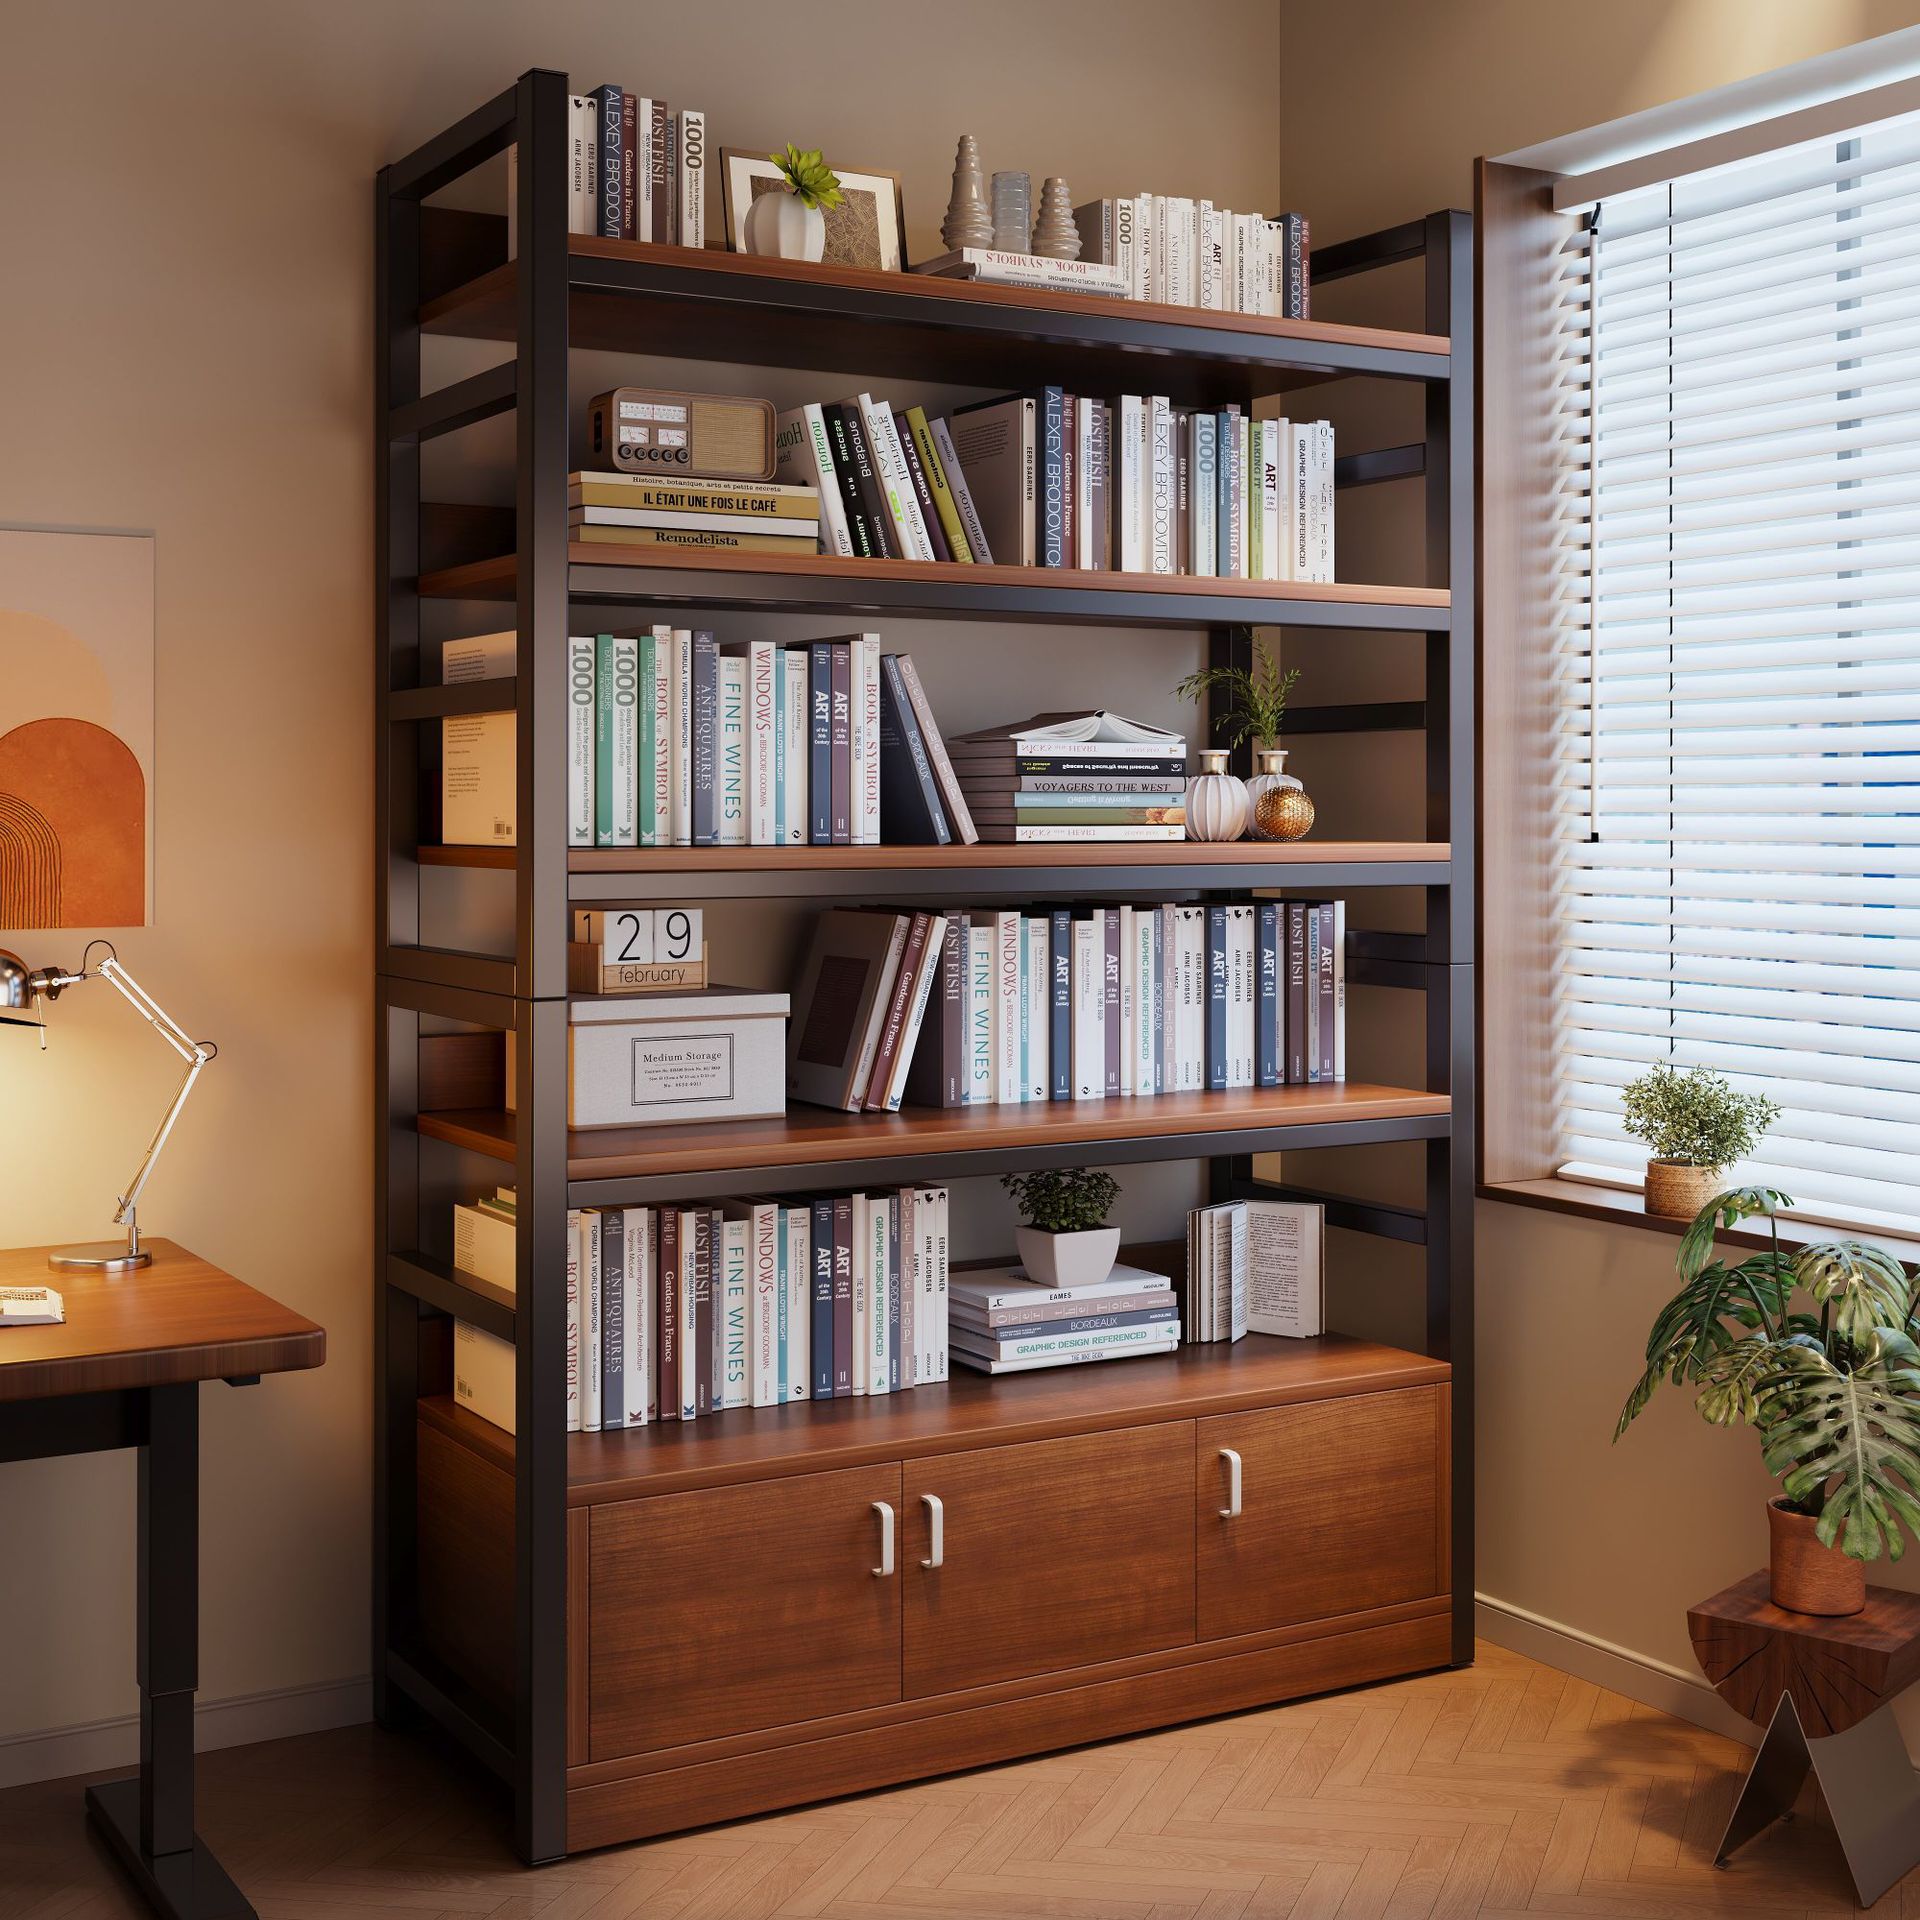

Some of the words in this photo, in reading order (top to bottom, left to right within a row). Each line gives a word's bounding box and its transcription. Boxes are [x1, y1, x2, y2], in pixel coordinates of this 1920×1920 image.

[653, 105, 664, 147] LOST
[686, 117, 702, 169] 1000
[574, 139, 582, 156] ARNE
[574, 158, 582, 192] JACOBSEN
[625, 149, 634, 186] Gardens
[653, 150, 664, 184] FISH
[625, 188, 634, 197] in
[625, 199, 634, 230] France
[1119, 204, 1132, 244] 1000
[1213, 243, 1222, 265] ART
[1292, 216, 1302, 264] ALEXEY
[1047, 390, 1061, 458] ALEXEY
[1091, 404, 1102, 448] LOST
[1199, 420, 1215, 473] 1000
[632, 476, 663, 485] Histoire,
[666, 479, 705, 488] botanique,
[1064, 452, 1073, 491] Gardens
[1091, 451, 1102, 487] FISH
[1179, 458, 1187, 475] EERO
[1265, 462, 1276, 491] ART
[643, 492, 654, 504] IL
[656, 491, 685, 507] ÉTAIT
[687, 494, 709, 508] UNE
[711, 496, 733, 510] FOIS
[736, 498, 748, 511] LE
[750, 498, 777, 513] CAFÉ
[1064, 493, 1073, 502] in
[1179, 477, 1187, 510] SAARINEN
[1064, 504, 1073, 537] France
[655, 531, 739, 547] Remodelista
[572, 644, 593, 706] 1000
[615, 646, 636, 706] 1000
[647, 648, 655, 673] TEXTILE
[647, 674, 655, 712] DESIGNERS
[655, 678, 668, 721] BOOK
[725, 683, 741, 733] FINE
[815, 690, 829, 723] ART
[834, 690, 848, 723] ART
[866, 683, 878, 725] BOOK
[701, 684, 712, 790] ANTIQUAIRES
[907, 730, 930, 781] BORDEAUX
[655, 738, 668, 815] SYMBOLS
[725, 744, 741, 820] WINES
[866, 741, 878, 815] SYMBOLS
[1034, 782, 1094, 792] VOYAGERS
[1097, 782, 1111, 792] TO
[1114, 782, 1137, 792] THE
[1141, 782, 1171, 792] WEST
[583, 913, 592, 944] 1
[946, 915, 959, 960] LOST
[1292, 908, 1303, 949] LOST
[618, 965, 686, 985] february
[929, 954, 938, 970] NEW
[974, 951, 989, 999] FINE
[1056, 955, 1069, 985] ART
[1106, 953, 1118, 983] ART
[1213, 950, 1225, 978] ART
[1263, 948, 1274, 977] ART
[1292, 951, 1303, 986] FISH
[1311, 963, 1318, 974] IT
[1321, 946, 1332, 974] ART
[895, 971, 913, 1011] Gardens
[921, 971, 934, 996] URBAN
[946, 962, 959, 1000] FISH
[893, 1012, 903, 1022] in
[913, 996, 929, 1027] HOUSING
[1154, 982, 1163, 1030] BORDEAUX
[643, 1053, 683, 1063] Medium
[686, 1051, 722, 1062] Storage
[883, 1024, 900, 1057] France
[974, 1009, 989, 1080] WINES
[636, 1227, 644, 1245] Detail
[695, 1212, 709, 1259] LOST
[875, 1216, 884, 1257] GRAPHIC
[635, 1254, 644, 1297] Contemporary
[728, 1246, 744, 1297] FINE
[817, 1247, 831, 1278] ART
[836, 1245, 850, 1276] ART
[875, 1259, 884, 1293] DESIGN
[664, 1271, 674, 1313] Gardens
[695, 1261, 709, 1303] FISH
[889, 1273, 899, 1325] BORDEAUX
[1049, 1292, 1072, 1301] EAMES
[610, 1266, 622, 1373] ANTIQUAIRES
[636, 1299, 644, 1333] Residential
[664, 1315, 674, 1326] in
[875, 1296, 884, 1357] REFERENCED
[1071, 1317, 1118, 1331] BORDEAUX
[636, 1334, 644, 1371] Architecture
[664, 1328, 674, 1362] France
[728, 1307, 744, 1382] WINES
[1016, 1342, 1055, 1354] GRAPHIC
[1058, 1339, 1089, 1349] DESIGN
[1092, 1331, 1147, 1345] REFERENCED
